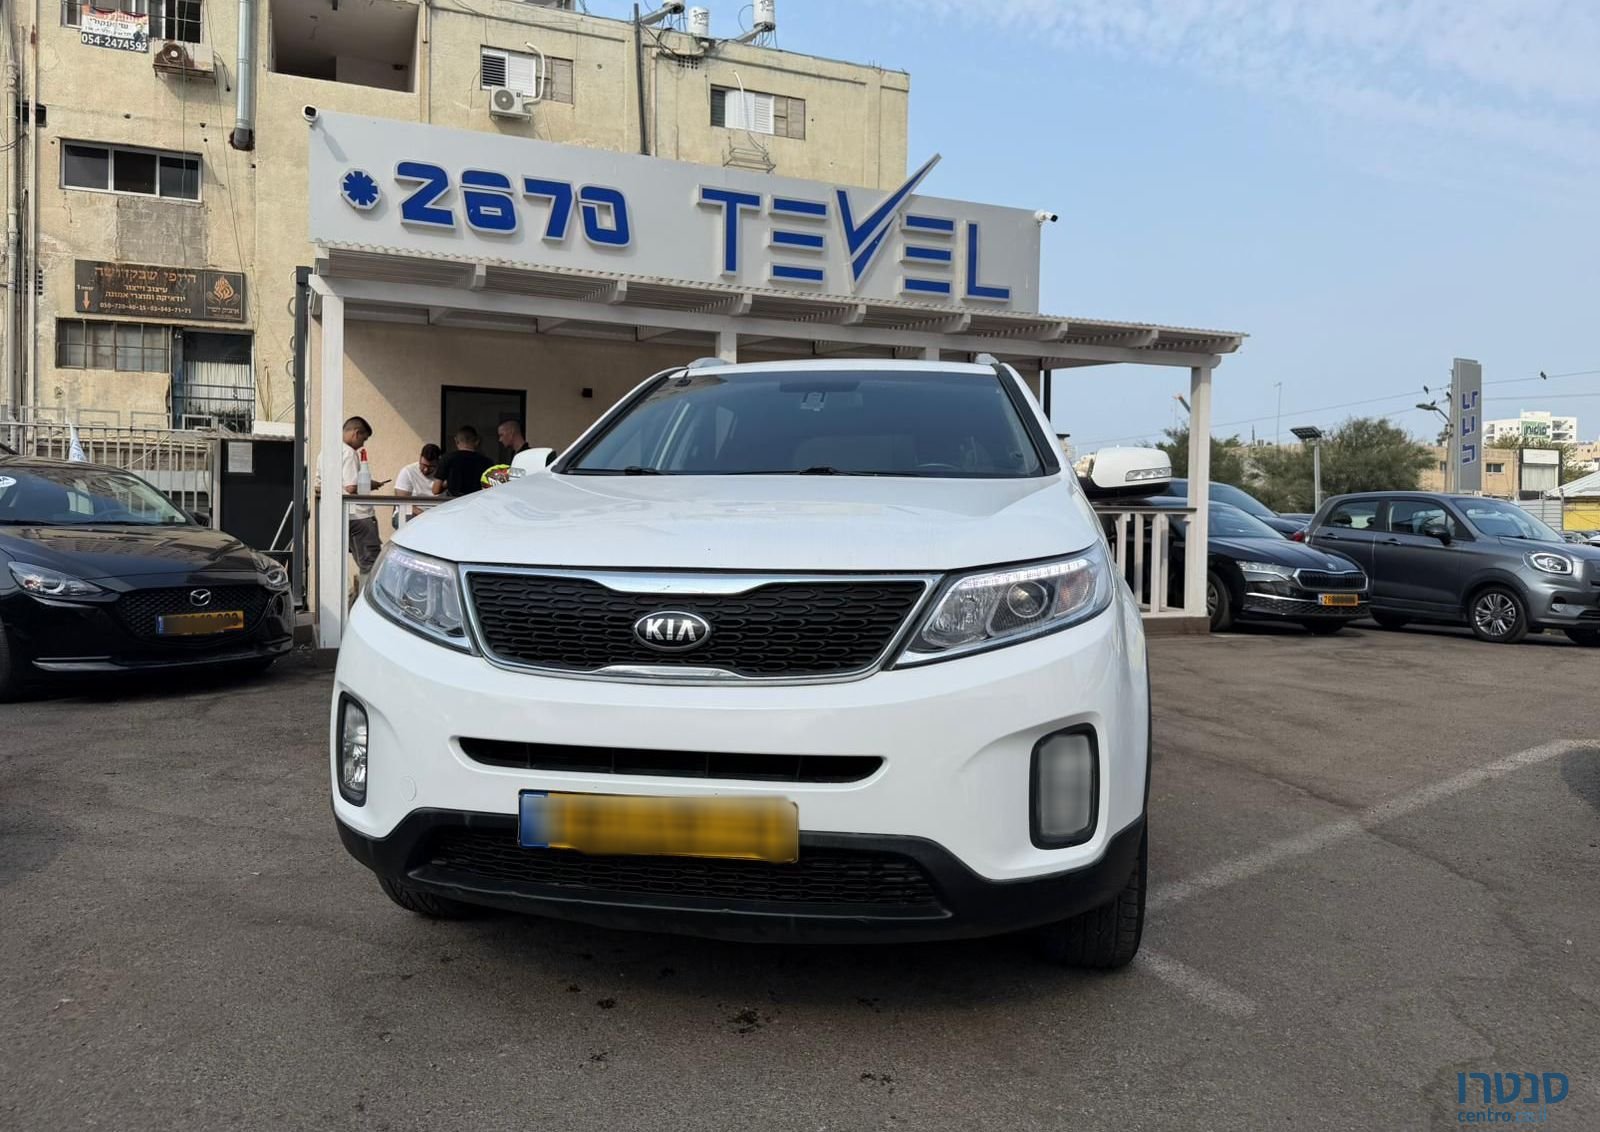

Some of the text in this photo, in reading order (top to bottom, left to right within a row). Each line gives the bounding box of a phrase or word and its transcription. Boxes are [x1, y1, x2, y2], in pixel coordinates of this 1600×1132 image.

[81, 33, 148, 51] 054-2474592
[394, 160, 632, 248] 2670
[697, 153, 1011, 303] TEVEL
[1462, 390, 1479, 465] תבל
[646, 618, 697, 641] KIA
